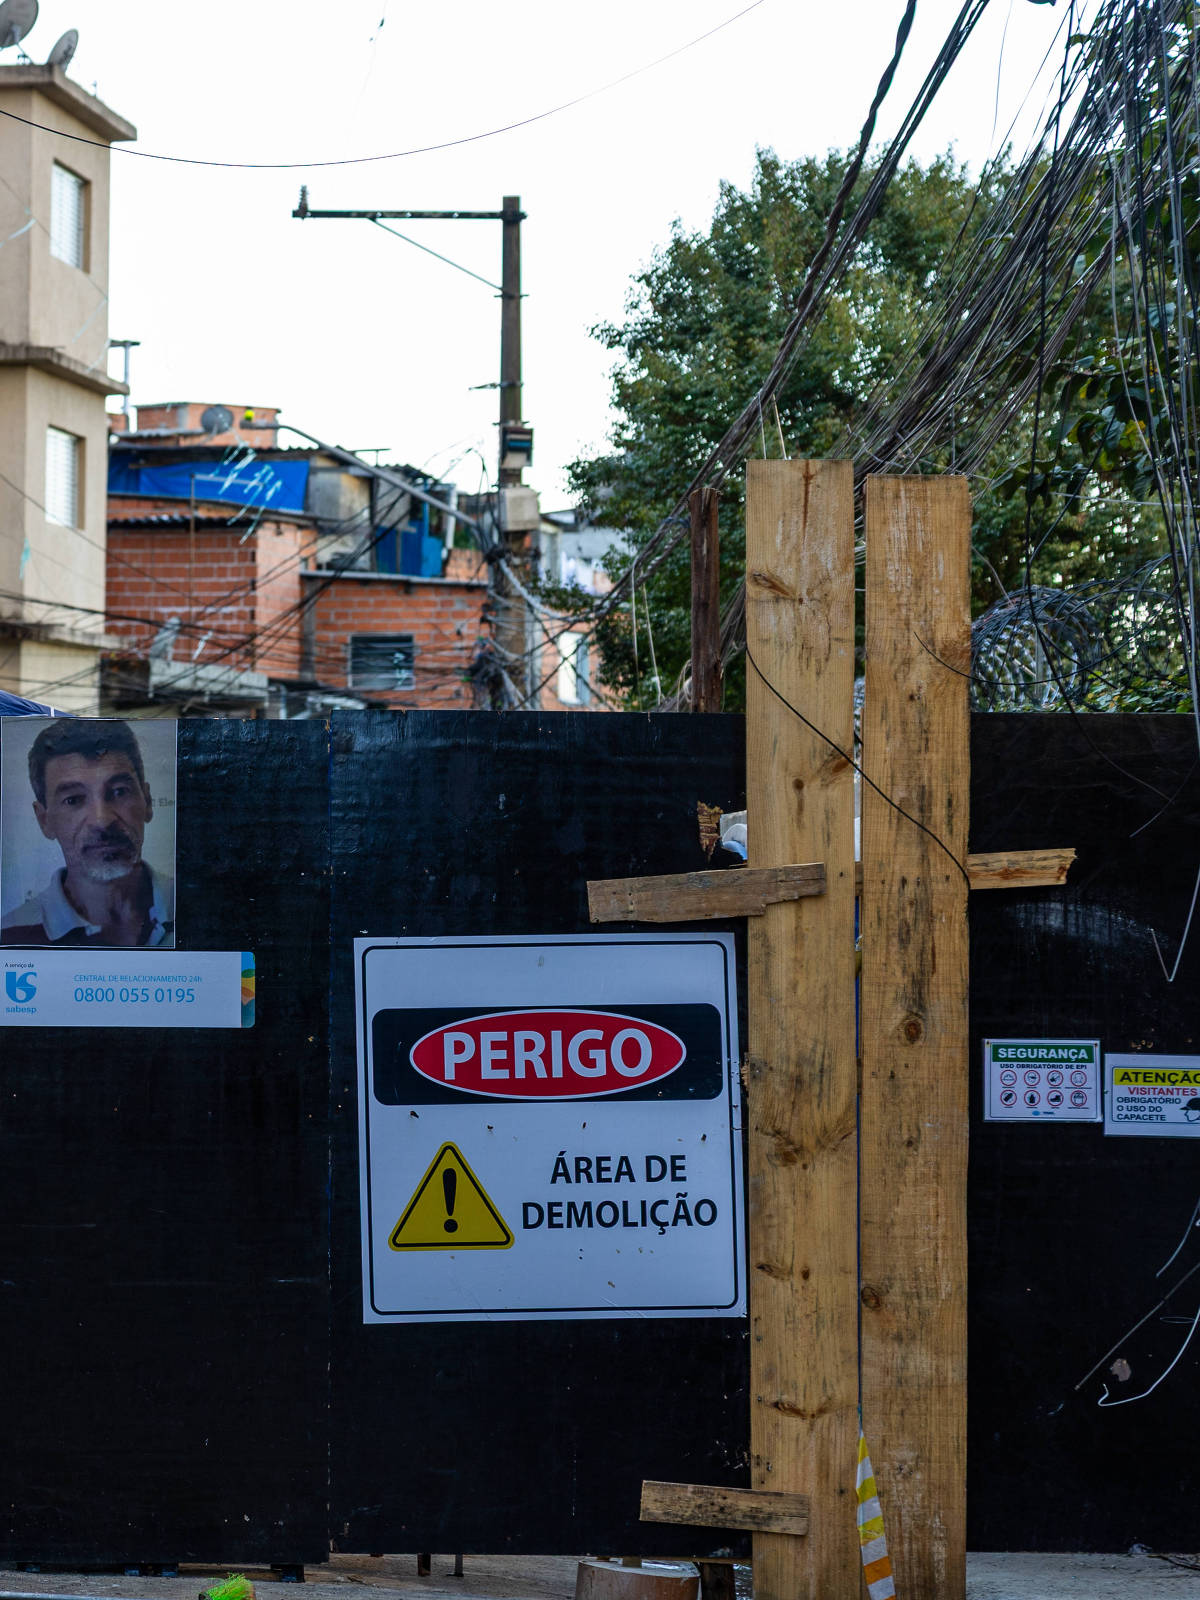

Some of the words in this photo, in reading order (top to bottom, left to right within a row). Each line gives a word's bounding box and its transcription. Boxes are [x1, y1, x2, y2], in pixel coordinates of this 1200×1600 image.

[73, 974, 106, 983] CENTRAL
[108, 974, 118, 983] DE
[118, 975, 188, 983] RELACIONAMENTO
[74, 987, 115, 1003] 0800
[119, 987, 150, 1003] 055
[154, 988, 195, 1003] 0195
[6, 1004, 37, 1014] sabesp
[443, 1028, 652, 1081] PERIGO
[998, 1047, 1089, 1061] SEGURANÇA
[1128, 1086, 1198, 1096] VISITANTES
[1117, 1096, 1182, 1104] OBRIGATÓRIO
[1116, 1104, 1124, 1112] O
[1149, 1105, 1163, 1113] DO
[1116, 1113, 1167, 1121] CAPACETE
[550, 1151, 636, 1184] ÁREA
[645, 1155, 687, 1182] DE
[522, 1192, 718, 1235] DEMOLIÇÃO
